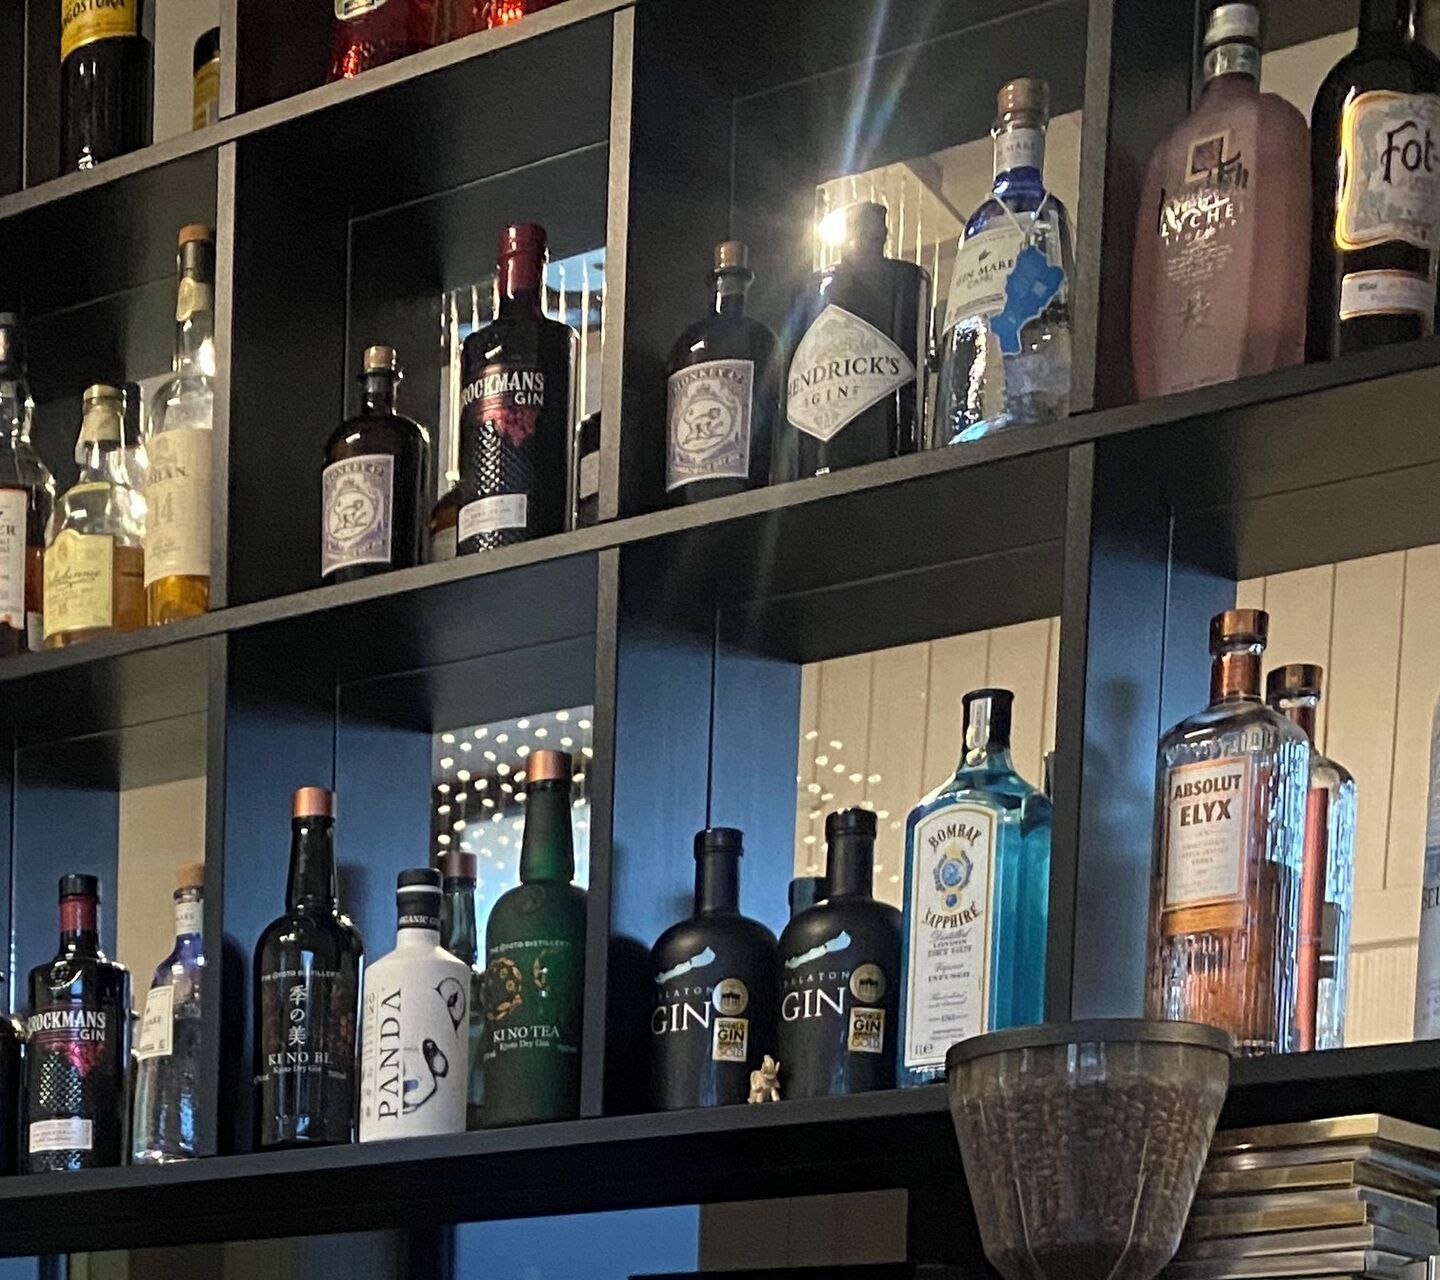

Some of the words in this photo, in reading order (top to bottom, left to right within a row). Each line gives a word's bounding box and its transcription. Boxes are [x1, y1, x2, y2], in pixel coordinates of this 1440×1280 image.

[463, 370, 545, 406] ROCKMANS
[514, 391, 545, 406] GIN
[812, 385, 850, 406] GIN
[152, 491, 173, 523] 14
[1173, 774, 1243, 800] ABSOLUT
[1180, 799, 1233, 827] ELYX
[928, 823, 982, 854] BOMBAY
[922, 900, 984, 929] SAPPHIRE
[288, 984, 309, 1046] 季の美
[651, 1000, 712, 1035] GIN
[781, 986, 847, 1022] GIN
[27, 1010, 107, 1040] ROCKMANS
[79, 1028, 106, 1042] GIN
[493, 1028, 505, 1042] KI
[508, 1025, 528, 1040] NO
[529, 1024, 560, 1038] TEA
[717, 1028, 745, 1042] GIN
[853, 1018, 882, 1033] GIN
[378, 987, 402, 1122] PANDA
[519, 1040, 534, 1049] Dry
[268, 1052, 282, 1066] KI
[286, 1051, 310, 1063] NO
[293, 1065, 307, 1073] Dry
